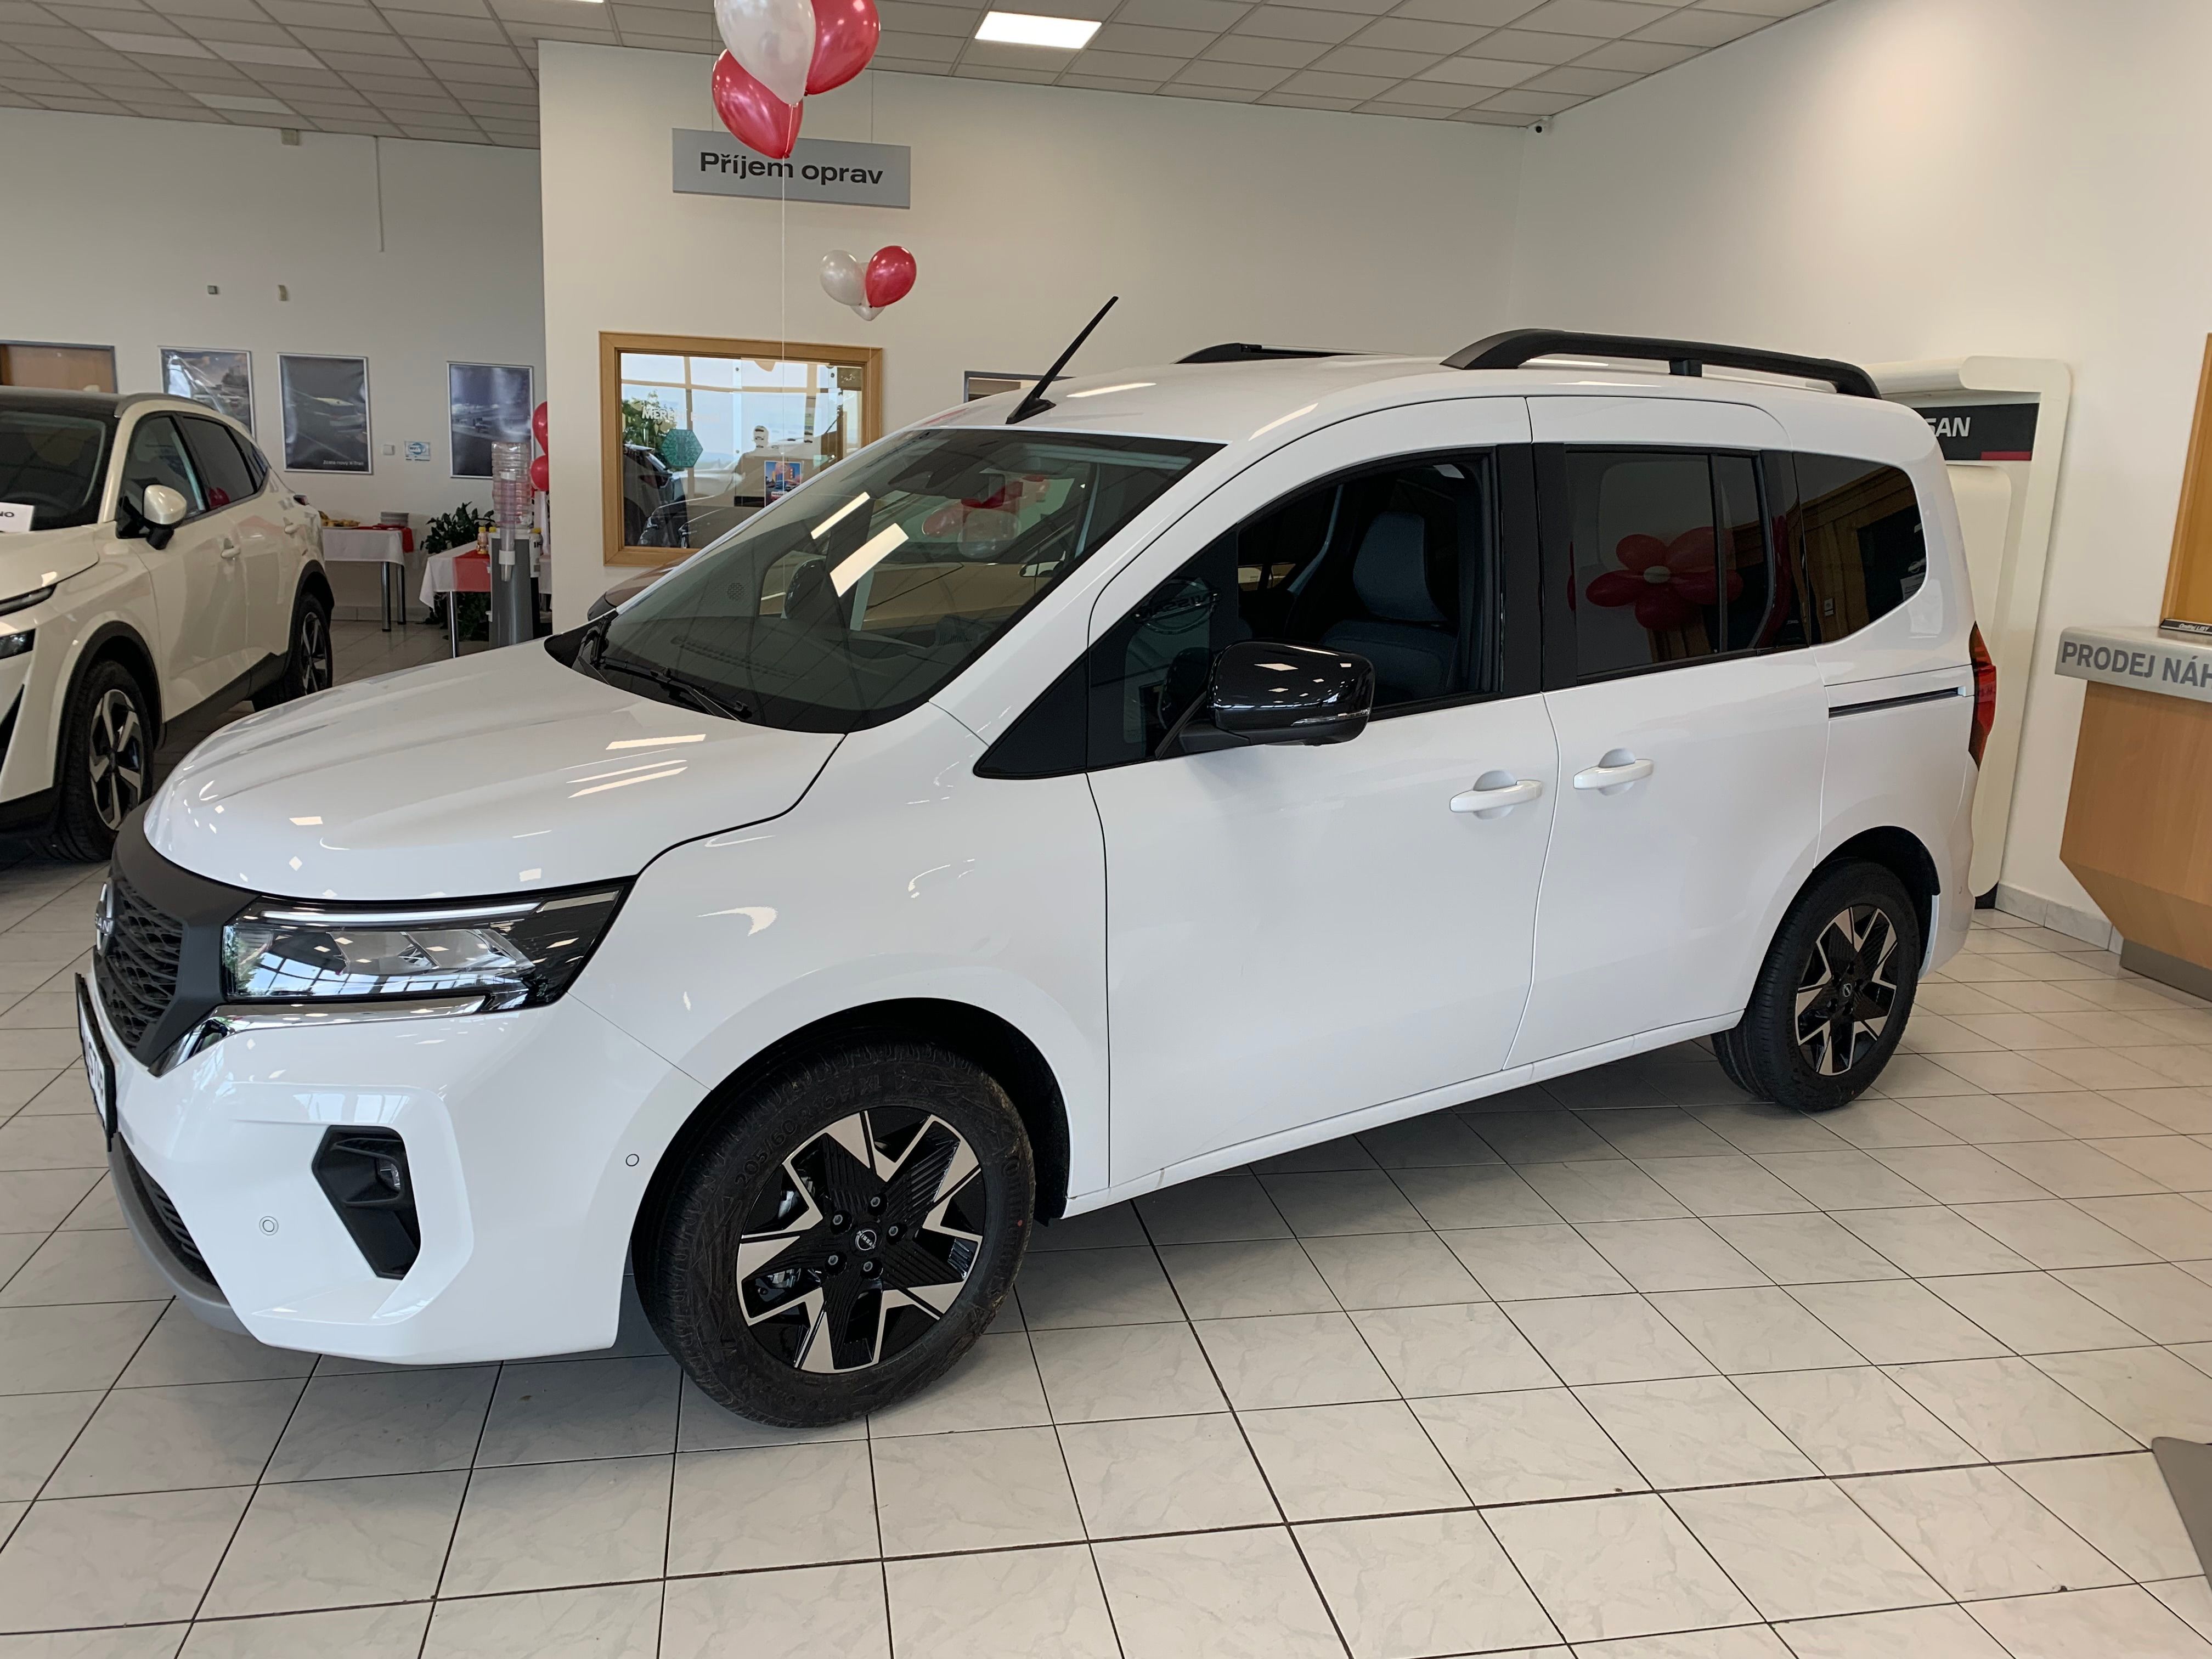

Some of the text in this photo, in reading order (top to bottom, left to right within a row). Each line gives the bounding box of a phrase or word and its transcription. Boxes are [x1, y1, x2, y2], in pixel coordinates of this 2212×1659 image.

[700, 152, 883, 185] Příjem oprav
[2062, 641, 2155, 678] PRODEJ
[734, 1116, 797, 1189] 205/60
[856, 1231, 876, 1249] NISSAN
